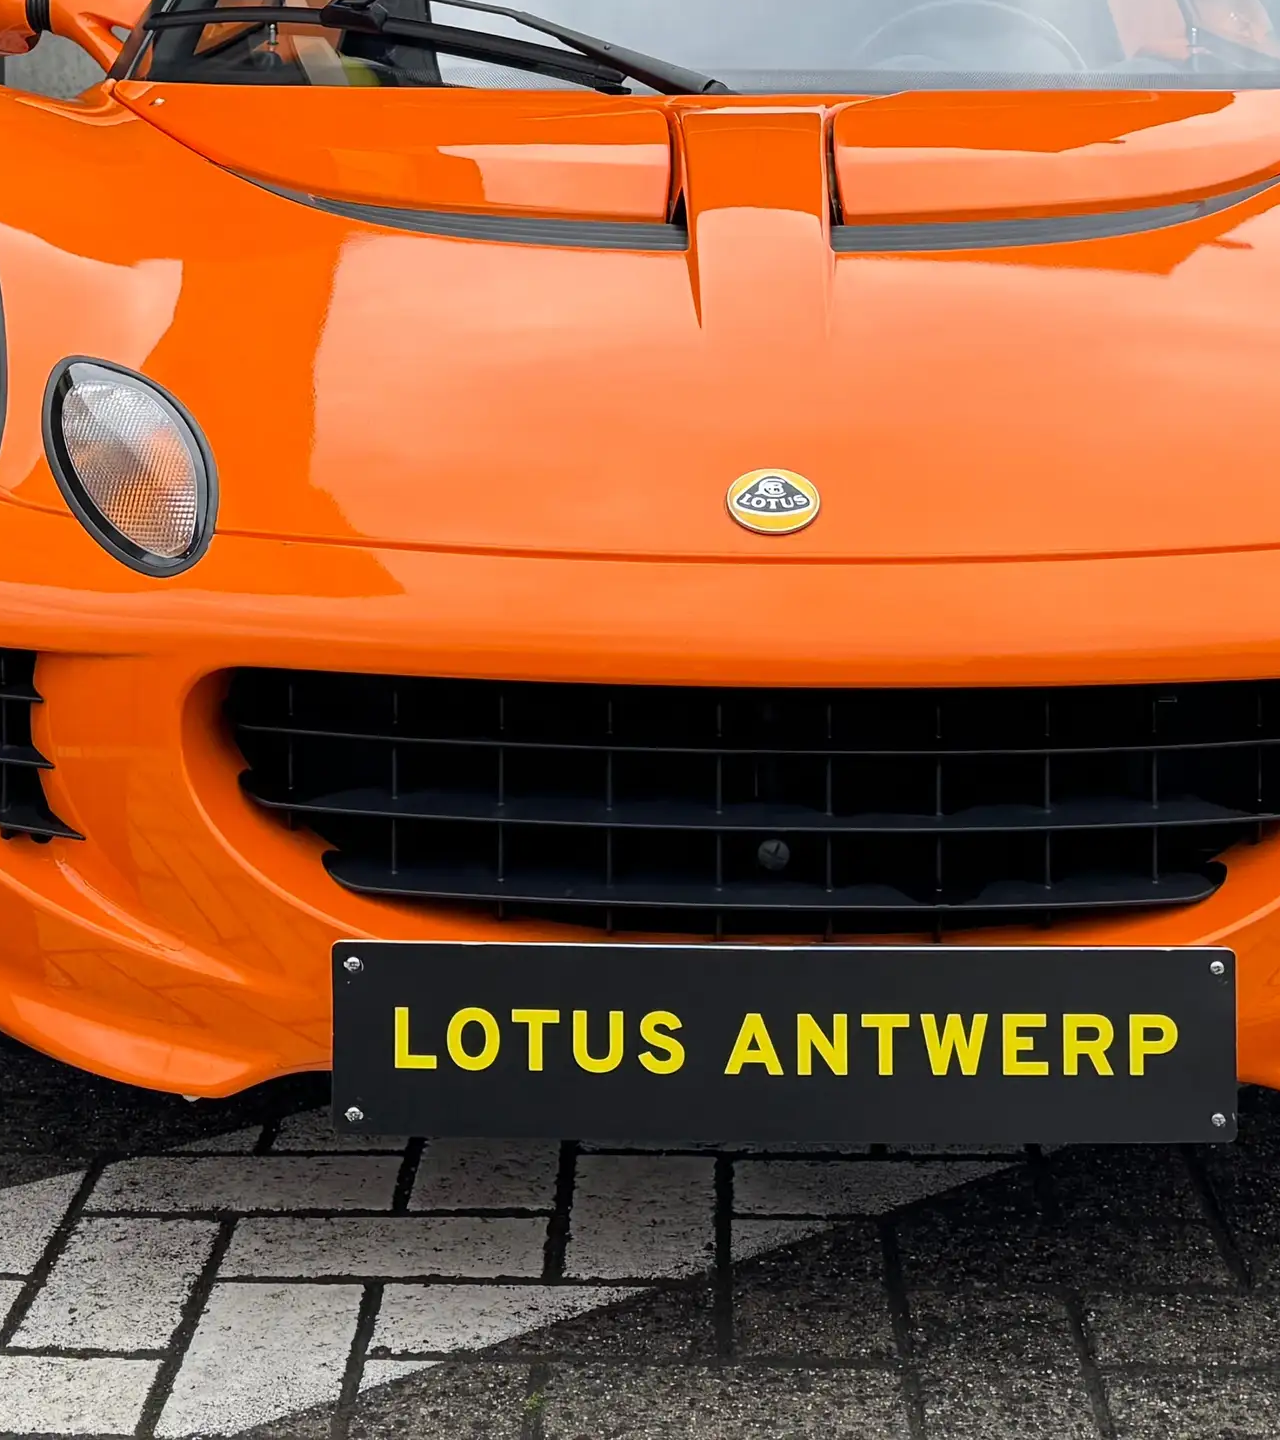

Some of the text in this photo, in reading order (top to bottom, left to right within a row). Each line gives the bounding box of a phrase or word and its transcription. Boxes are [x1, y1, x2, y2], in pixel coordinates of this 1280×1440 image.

[739, 493, 809, 510] LOTUS
[393, 1006, 1179, 1076] LOTUS ANTWERP
